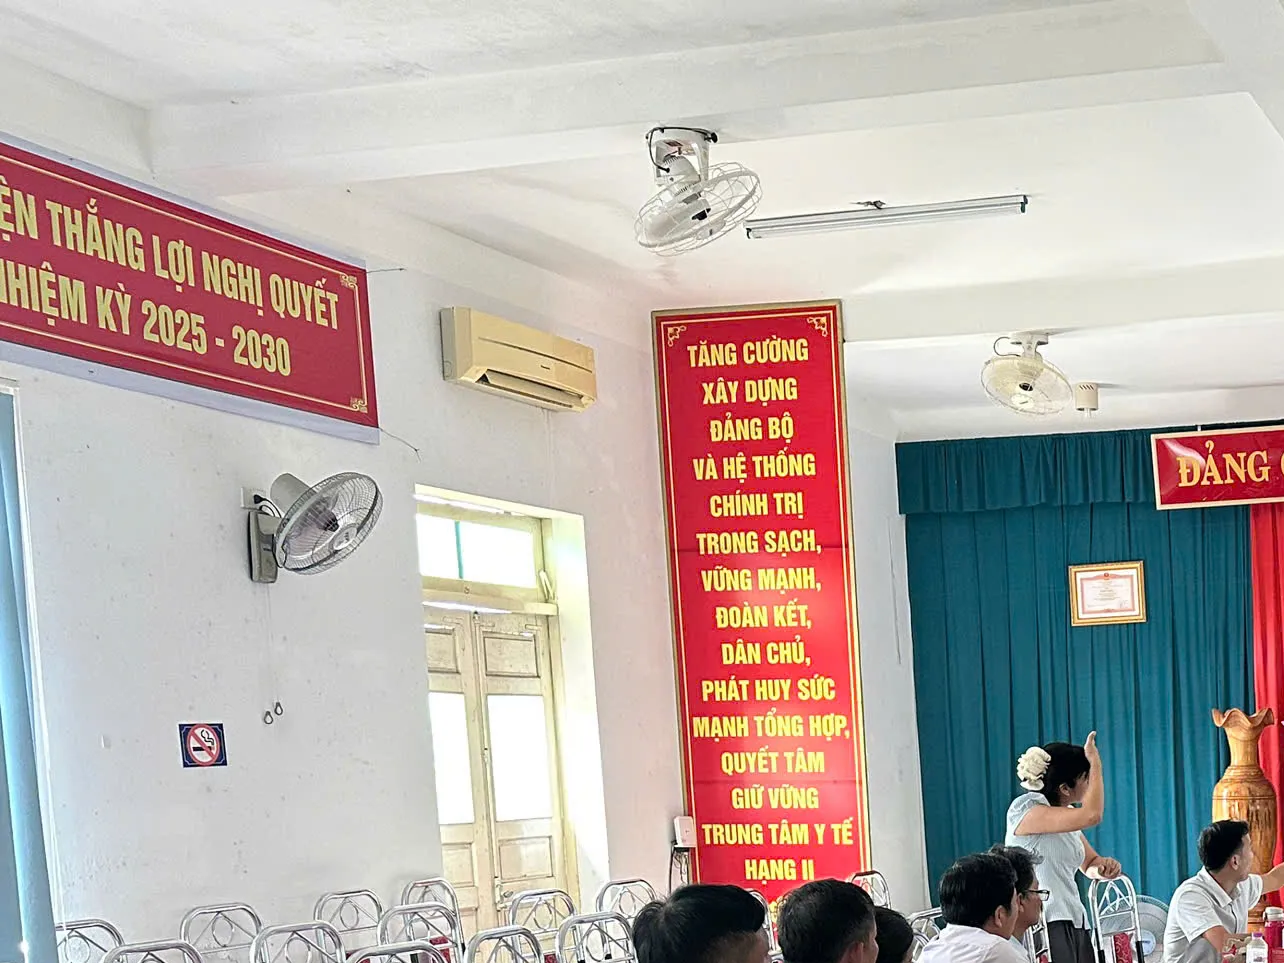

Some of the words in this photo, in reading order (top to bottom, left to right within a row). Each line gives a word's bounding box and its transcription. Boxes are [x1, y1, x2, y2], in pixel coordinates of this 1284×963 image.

[45, 198, 145, 272] THẮNG
[152, 235, 195, 292] LỢI
[202, 251, 263, 316] NGHỊ
[270, 278, 338, 329] QUYẾT
[96, 283, 131, 335] KỲ
[142, 300, 207, 354] 2025
[216, 338, 224, 347] -
[232, 326, 290, 376] 2030
[687, 340, 737, 367] TĂNG
[743, 335, 808, 364] CƯỜNG
[702, 377, 738, 404] XÂY
[745, 377, 797, 406] DỰNG
[710, 412, 762, 441] ĐẢNG
[768, 412, 793, 443] BỘ
[693, 454, 718, 480] VÀ
[723, 452, 747, 483] HỆ
[752, 447, 815, 477] THỐNG
[1177, 440, 1270, 486] ĐẢNG
[710, 490, 768, 517] CHÍNH
[773, 492, 803, 518] TRỊ
[696, 531, 758, 554] TRONG
[765, 530, 821, 557] SẠCH,
[702, 566, 752, 592] VỮNG
[758, 568, 821, 594] MẠNH,
[716, 601, 768, 628] ĐOÀN
[773, 598, 811, 629] KẾT,
[722, 639, 761, 664] DÂN
[767, 635, 810, 665] CHỦ,
[702, 676, 749, 701] PHÁT
[755, 679, 791, 700] HUY
[798, 674, 835, 700] SỨC
[693, 716, 749, 742] MẠNH
[754, 708, 804, 737] TỔNG
[809, 713, 849, 741] HỢP,
[722, 745, 780, 775] QUYẾT
[784, 748, 824, 773] TÂM
[732, 784, 764, 809] GIỮ
[768, 784, 819, 808] VỮNG
[702, 824, 763, 844] TRUNG
[768, 819, 809, 844] TÂM
[814, 824, 825, 844] Y
[831, 817, 853, 844] TẾ
[745, 859, 796, 884] HẠNG
[802, 860, 814, 882] II
